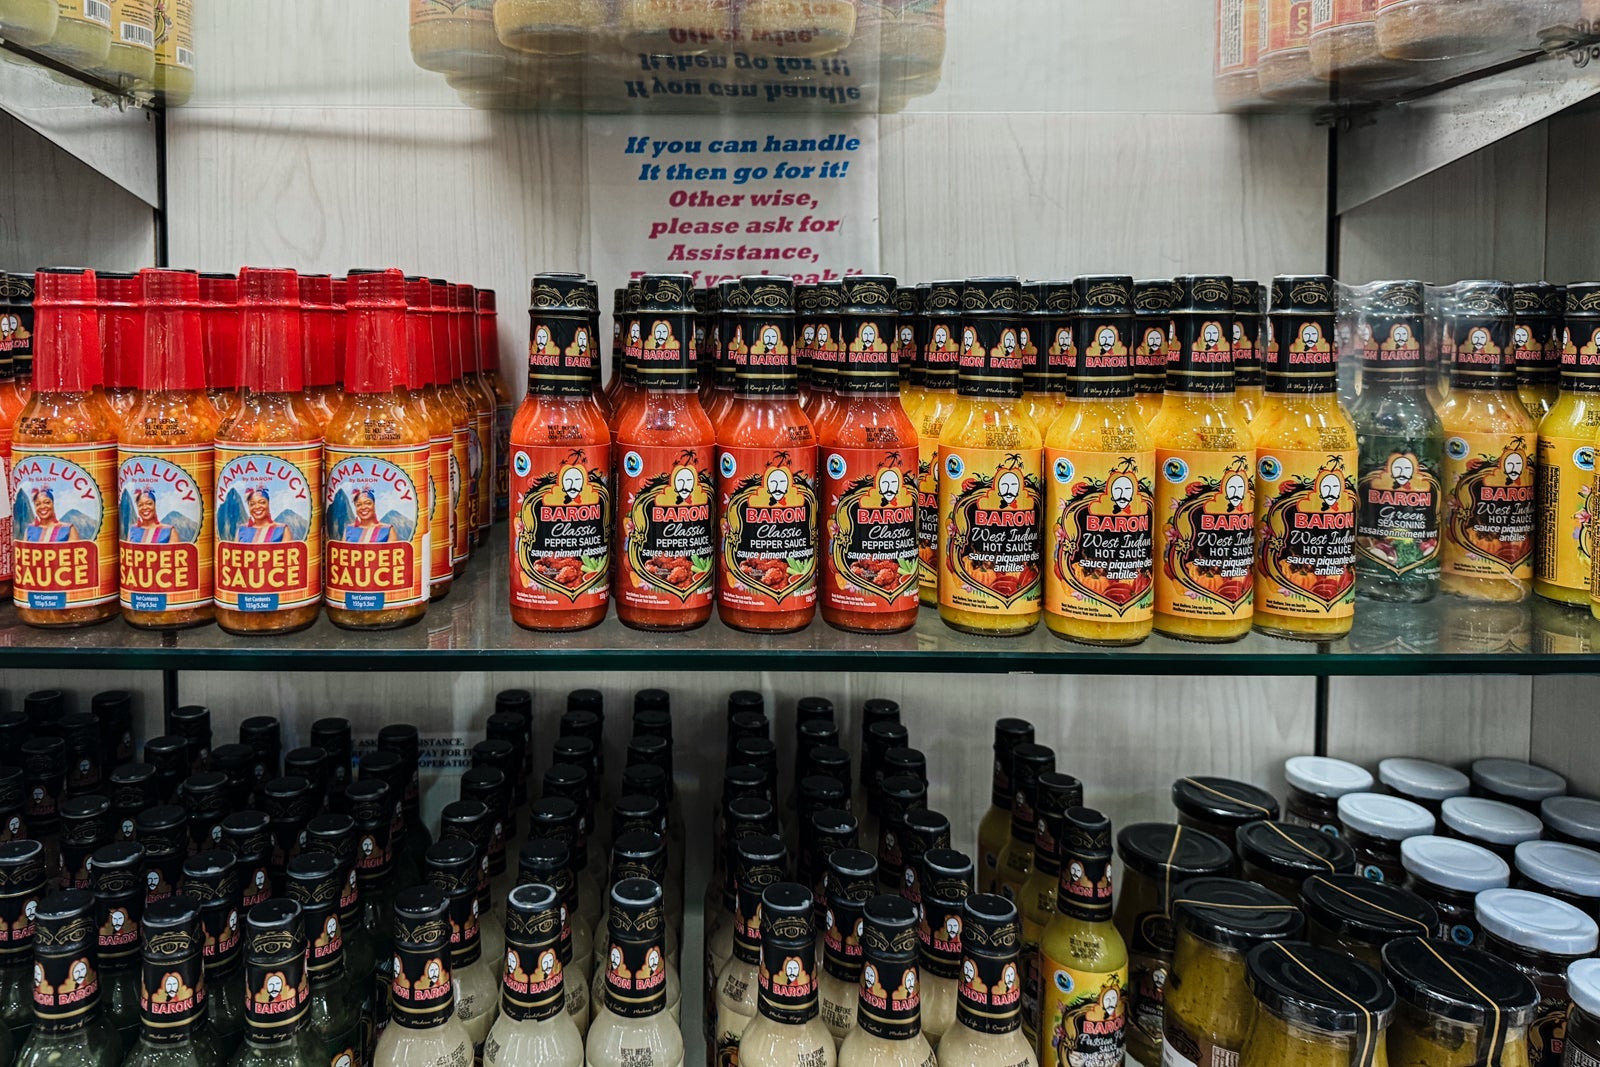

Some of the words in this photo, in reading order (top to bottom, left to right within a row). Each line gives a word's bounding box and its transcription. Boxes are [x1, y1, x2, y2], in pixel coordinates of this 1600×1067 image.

[624, 136, 649, 154] If
[652, 139, 702, 158] you
[708, 138, 759, 154] can
[763, 134, 860, 153] handle
[638, 164, 662, 181] It
[666, 163, 728, 181] then
[733, 166, 768, 185] go
[774, 162, 815, 181] for
[819, 161, 849, 179] it!
[668, 189, 745, 208] Other
[750, 189, 819, 210] wise,
[649, 217, 741, 240] please
[745, 217, 793, 235] ask
[799, 215, 840, 234] for
[667, 244, 820, 264] Assistance,
[644, 349, 680, 361] BARON
[750, 354, 789, 366] BARON
[849, 351, 888, 363] BARON
[1086, 356, 1127, 368] BARON
[1192, 350, 1231, 364] BARON
[1289, 351, 1331, 365] BARON
[1380, 349, 1420, 361] BARON
[1458, 351, 1500, 365] BARON
[49, 462, 96, 502] LUCY
[151, 462, 197, 503] LUCY
[218, 460, 258, 502] MAMA
[265, 461, 308, 501] LUCY
[371, 462, 413, 502] LUCY
[1368, 489, 1432, 507] BARON
[540, 505, 600, 522] BARON
[652, 505, 709, 522] BARON
[746, 507, 806, 524] BARON
[857, 507, 914, 524] BARON
[1379, 506, 1426, 522] Green
[1476, 502, 1512, 516] West
[974, 510, 1035, 527] BARON
[1086, 516, 1148, 532] BARON
[1201, 514, 1254, 531] BARO
[1294, 512, 1354, 530] BARON
[1378, 518, 1426, 530] SEASONING
[1488, 516, 1508, 525] HOT
[1510, 515, 1532, 525] SAUCE
[551, 523, 598, 537] Classic
[662, 523, 706, 537] Classic
[756, 525, 802, 539] Classic
[868, 526, 910, 540] Classic
[1358, 526, 1426, 539] assaisonnement
[1426, 529, 1438, 538] vert
[1473, 522, 1500, 533] sauce
[544, 536, 578, 548] PEPPER
[578, 536, 601, 546] SAUCE
[656, 536, 689, 548] PEPPER
[690, 536, 709, 546] SAUCE
[972, 528, 1006, 542] West
[1082, 533, 1120, 548] West
[1197, 532, 1234, 547] West
[1290, 530, 1328, 546] West
[1498, 534, 1527, 543] antilles
[750, 538, 784, 550] PEPPER
[784, 538, 807, 548] SAUCE
[862, 540, 894, 550] PEPPER
[894, 538, 914, 549] SAUCE
[982, 542, 1002, 552] HOT
[1006, 542, 1032, 552] SAUCE
[1210, 547, 1228, 556] HOT
[1232, 546, 1254, 556] SAUCE
[1302, 546, 1322, 556] HOT
[1326, 545, 1352, 556] SAUCE
[15, 547, 89, 566] PEPPER
[120, 547, 188, 569] PEPPER
[222, 548, 300, 568] PEPPER
[331, 548, 405, 568] PEPPER
[530, 550, 554, 558] sauce
[554, 550, 583, 559] piment
[583, 545, 608, 556] classiqu
[642, 549, 663, 558] sauce
[736, 551, 759, 560] sauce
[760, 550, 788, 560] piment
[788, 547, 814, 558] classiqu
[848, 551, 870, 560] sauce
[871, 551, 898, 561] piment
[968, 552, 994, 562] sauce
[996, 552, 1030, 566] piquante
[1094, 549, 1116, 559] HOT
[1119, 548, 1146, 558] SAUCE
[994, 562, 1024, 572] antilles
[1079, 559, 1106, 568] sauce
[1108, 560, 1143, 574] piquante
[1194, 558, 1221, 568] sauce
[1286, 556, 1315, 564] sauce
[1316, 556, 1348, 570] piquante
[15, 565, 89, 587] SAUCE
[120, 565, 189, 588] SAUCE
[222, 566, 300, 589] SAUCE
[331, 566, 405, 588] SAUCE
[1106, 570, 1138, 580] antilles
[1220, 568, 1248, 578] antilles
[1314, 566, 1344, 576] antilles
[98, 930, 138, 946] BARON
[772, 982, 810, 997] BARON
[152, 997, 194, 1015] BARON
[254, 998, 296, 1015] BARON
